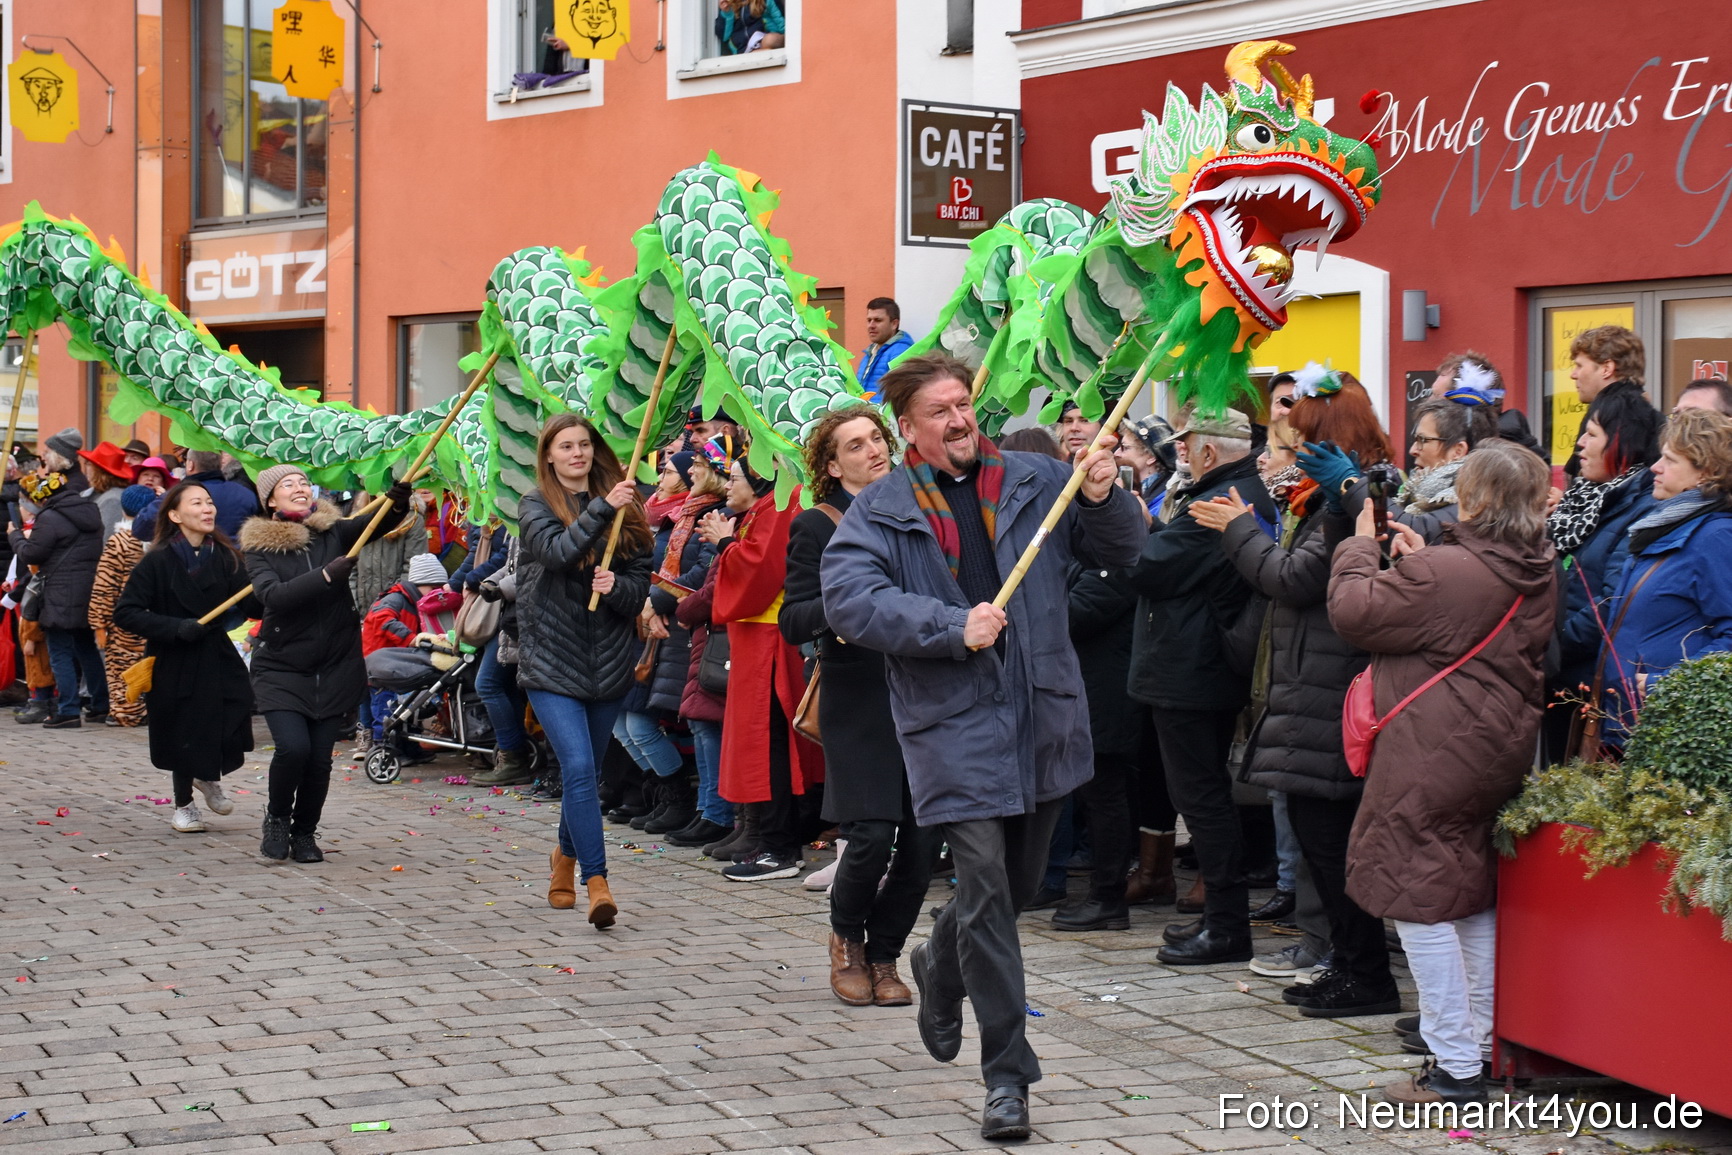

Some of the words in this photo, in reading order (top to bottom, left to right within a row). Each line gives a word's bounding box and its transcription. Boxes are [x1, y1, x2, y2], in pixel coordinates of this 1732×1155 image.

[281, 64, 298, 84] 人
[1376, 60, 1499, 158] Mode
[1503, 81, 1642, 172] Genuss
[920, 123, 1004, 171] CAFÉ
[1431, 56, 1662, 230] Mode
[941, 204, 979, 220] BAY.CHI
[186, 251, 327, 302] GÖTZ
